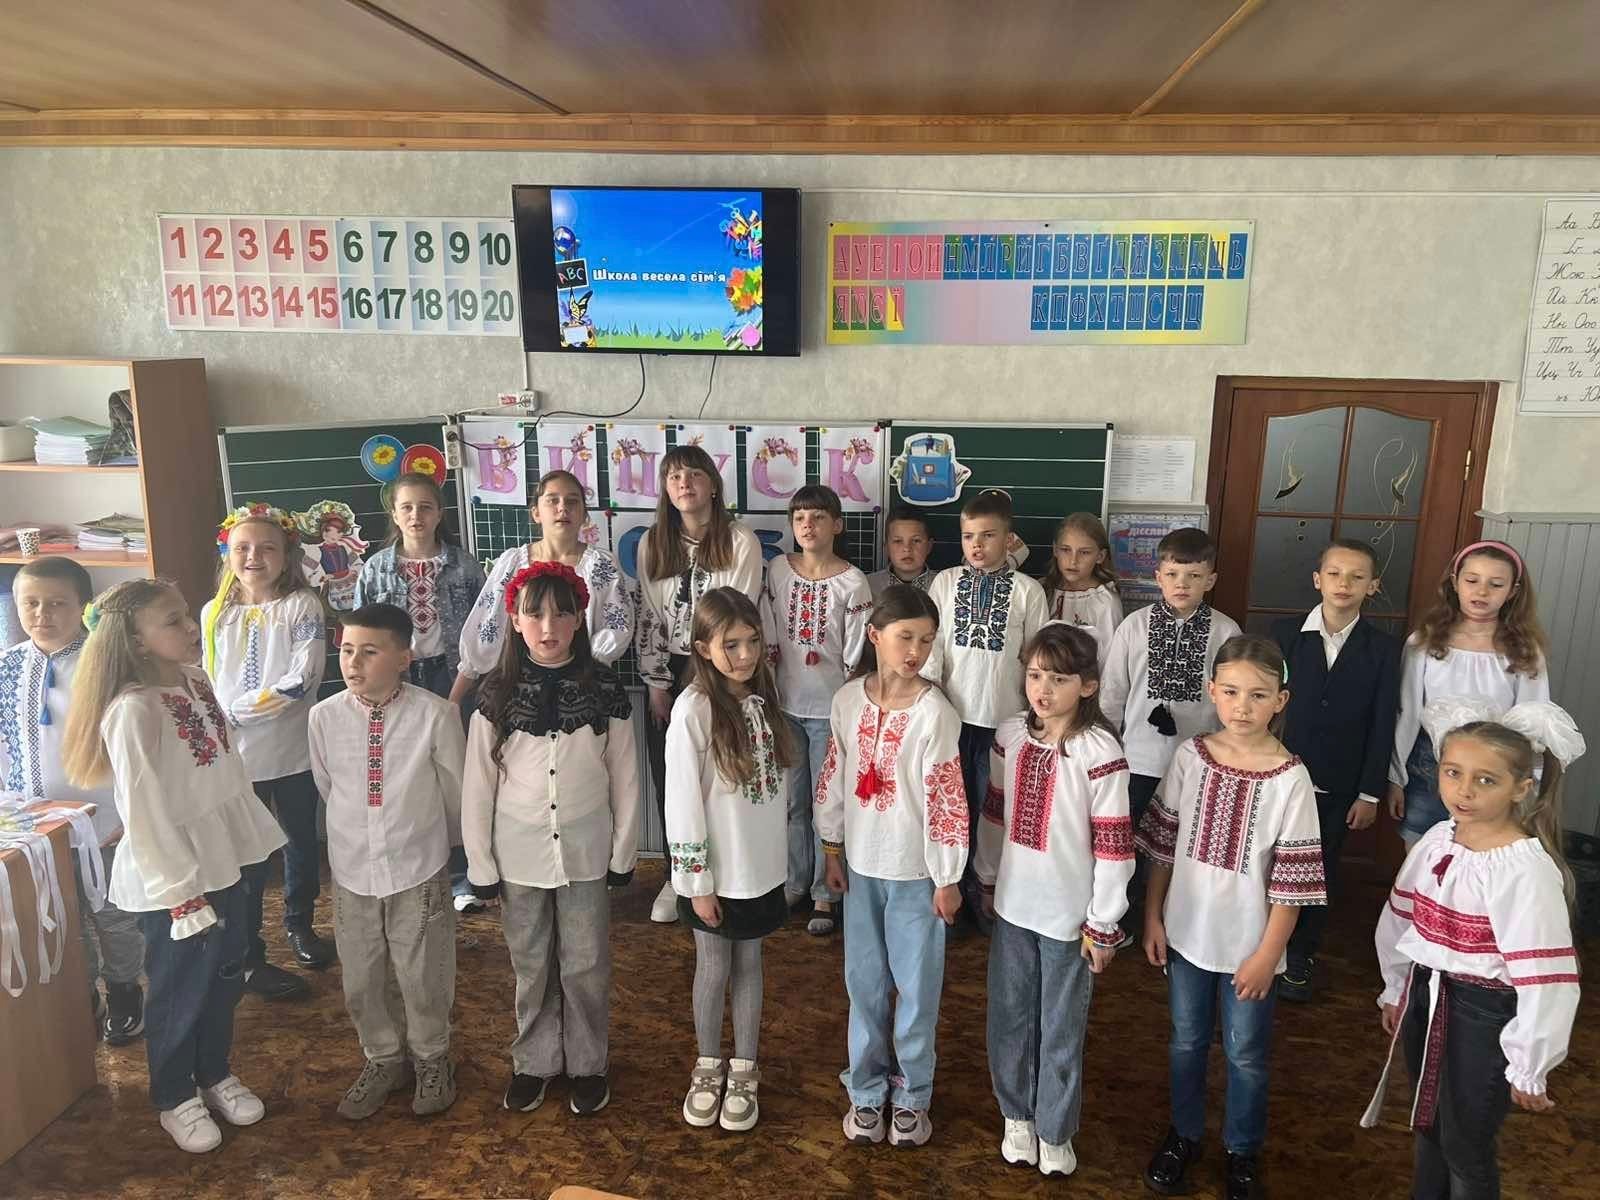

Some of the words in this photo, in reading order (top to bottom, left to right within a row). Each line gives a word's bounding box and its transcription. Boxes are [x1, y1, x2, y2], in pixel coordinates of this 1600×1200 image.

[170, 226, 187, 259] 1
[202, 227, 225, 260] 2
[238, 227, 259, 261] 3
[272, 228, 295, 261] 4
[308, 229, 329, 262] 5
[343, 230, 364, 263] 6
[377, 230, 398, 263] 7
[413, 230, 435, 264] 8
[449, 230, 470, 264] 9
[480, 232, 511, 266] 10
[557, 266, 585, 285] ABC
[592, 268, 638, 281] Школа
[642, 271, 687, 282] весела
[170, 284, 197, 316] 11
[202, 284, 235, 317] 12
[237, 285, 269, 318] 13
[272, 286, 304, 318] 14
[307, 286, 338, 319] 15
[342, 287, 373, 320] 16
[377, 287, 407, 320] 17
[412, 288, 443, 321] 18
[448, 289, 478, 322] 19
[483, 289, 514, 322] 20
